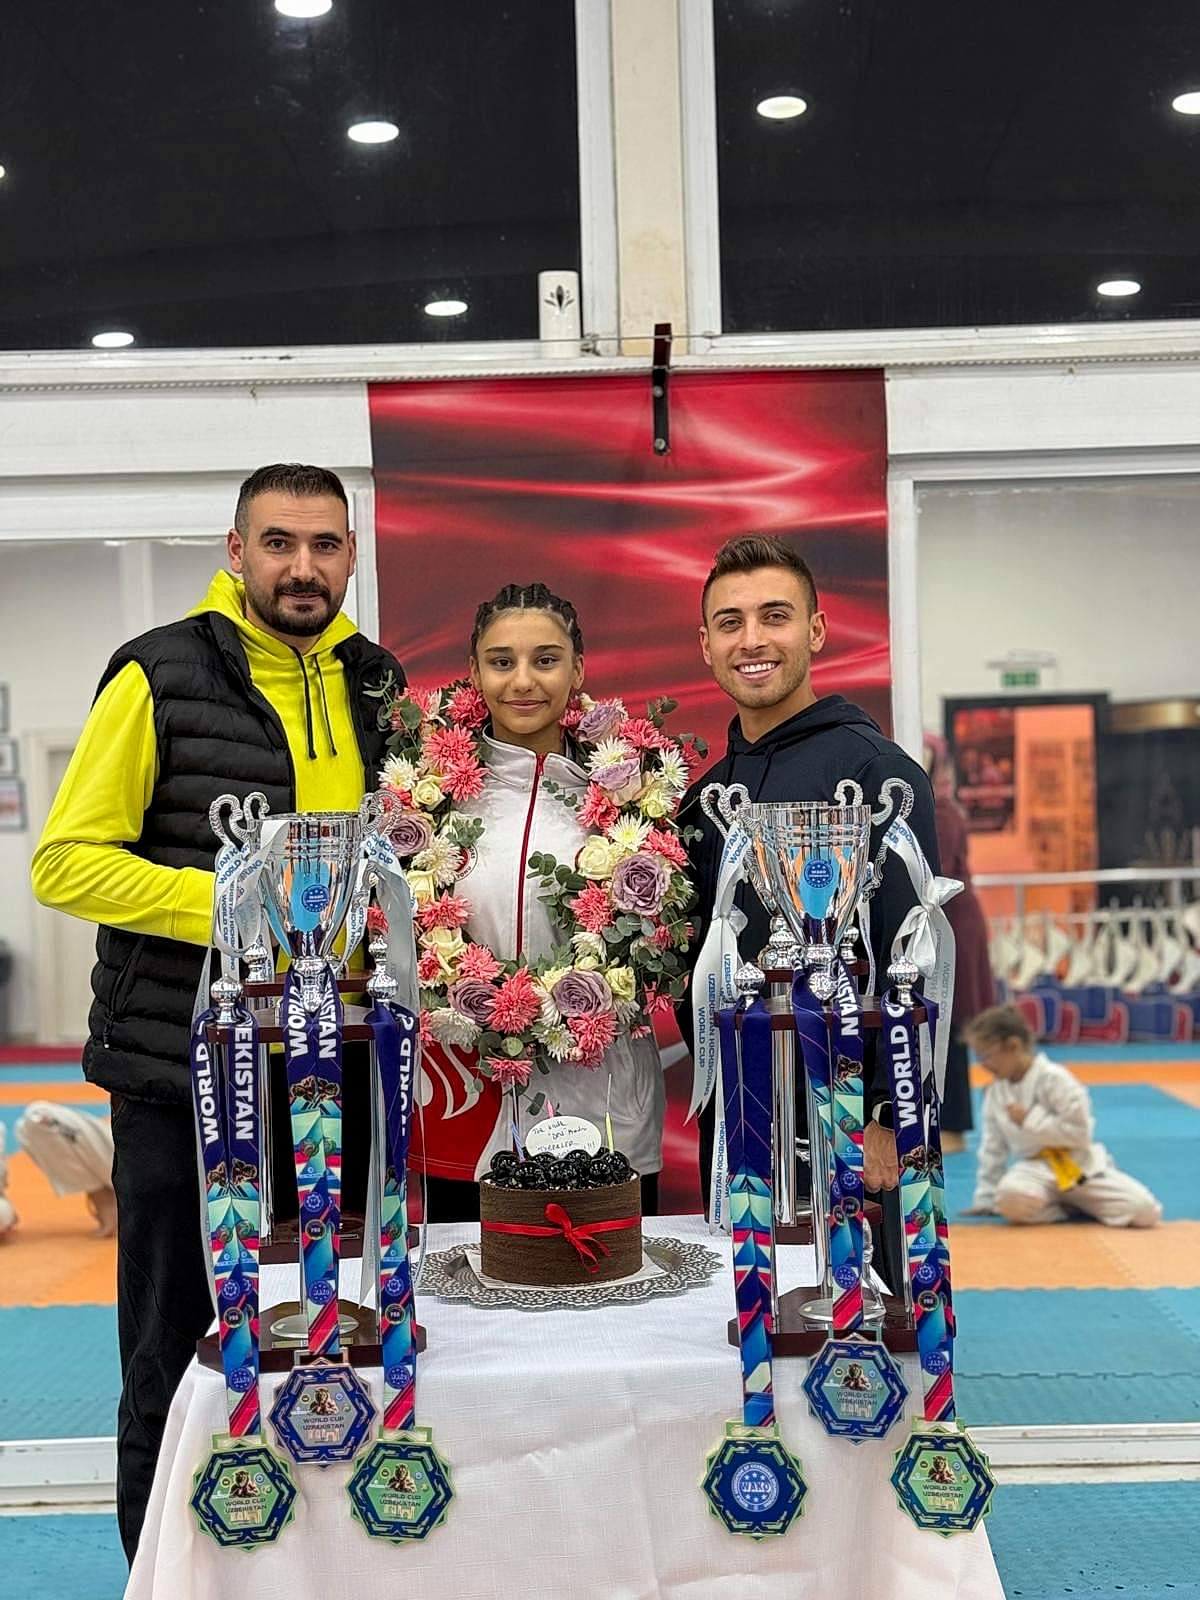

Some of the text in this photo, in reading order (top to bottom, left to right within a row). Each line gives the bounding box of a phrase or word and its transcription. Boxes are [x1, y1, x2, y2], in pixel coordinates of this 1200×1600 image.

[235, 1026, 254, 1140] EKISTAN
[400, 1037, 412, 1137] ORLD
[698, 1007, 706, 1068] WORLD CUP
[890, 1025, 918, 1129] WORLD
[196, 1042, 219, 1145] WORLD
